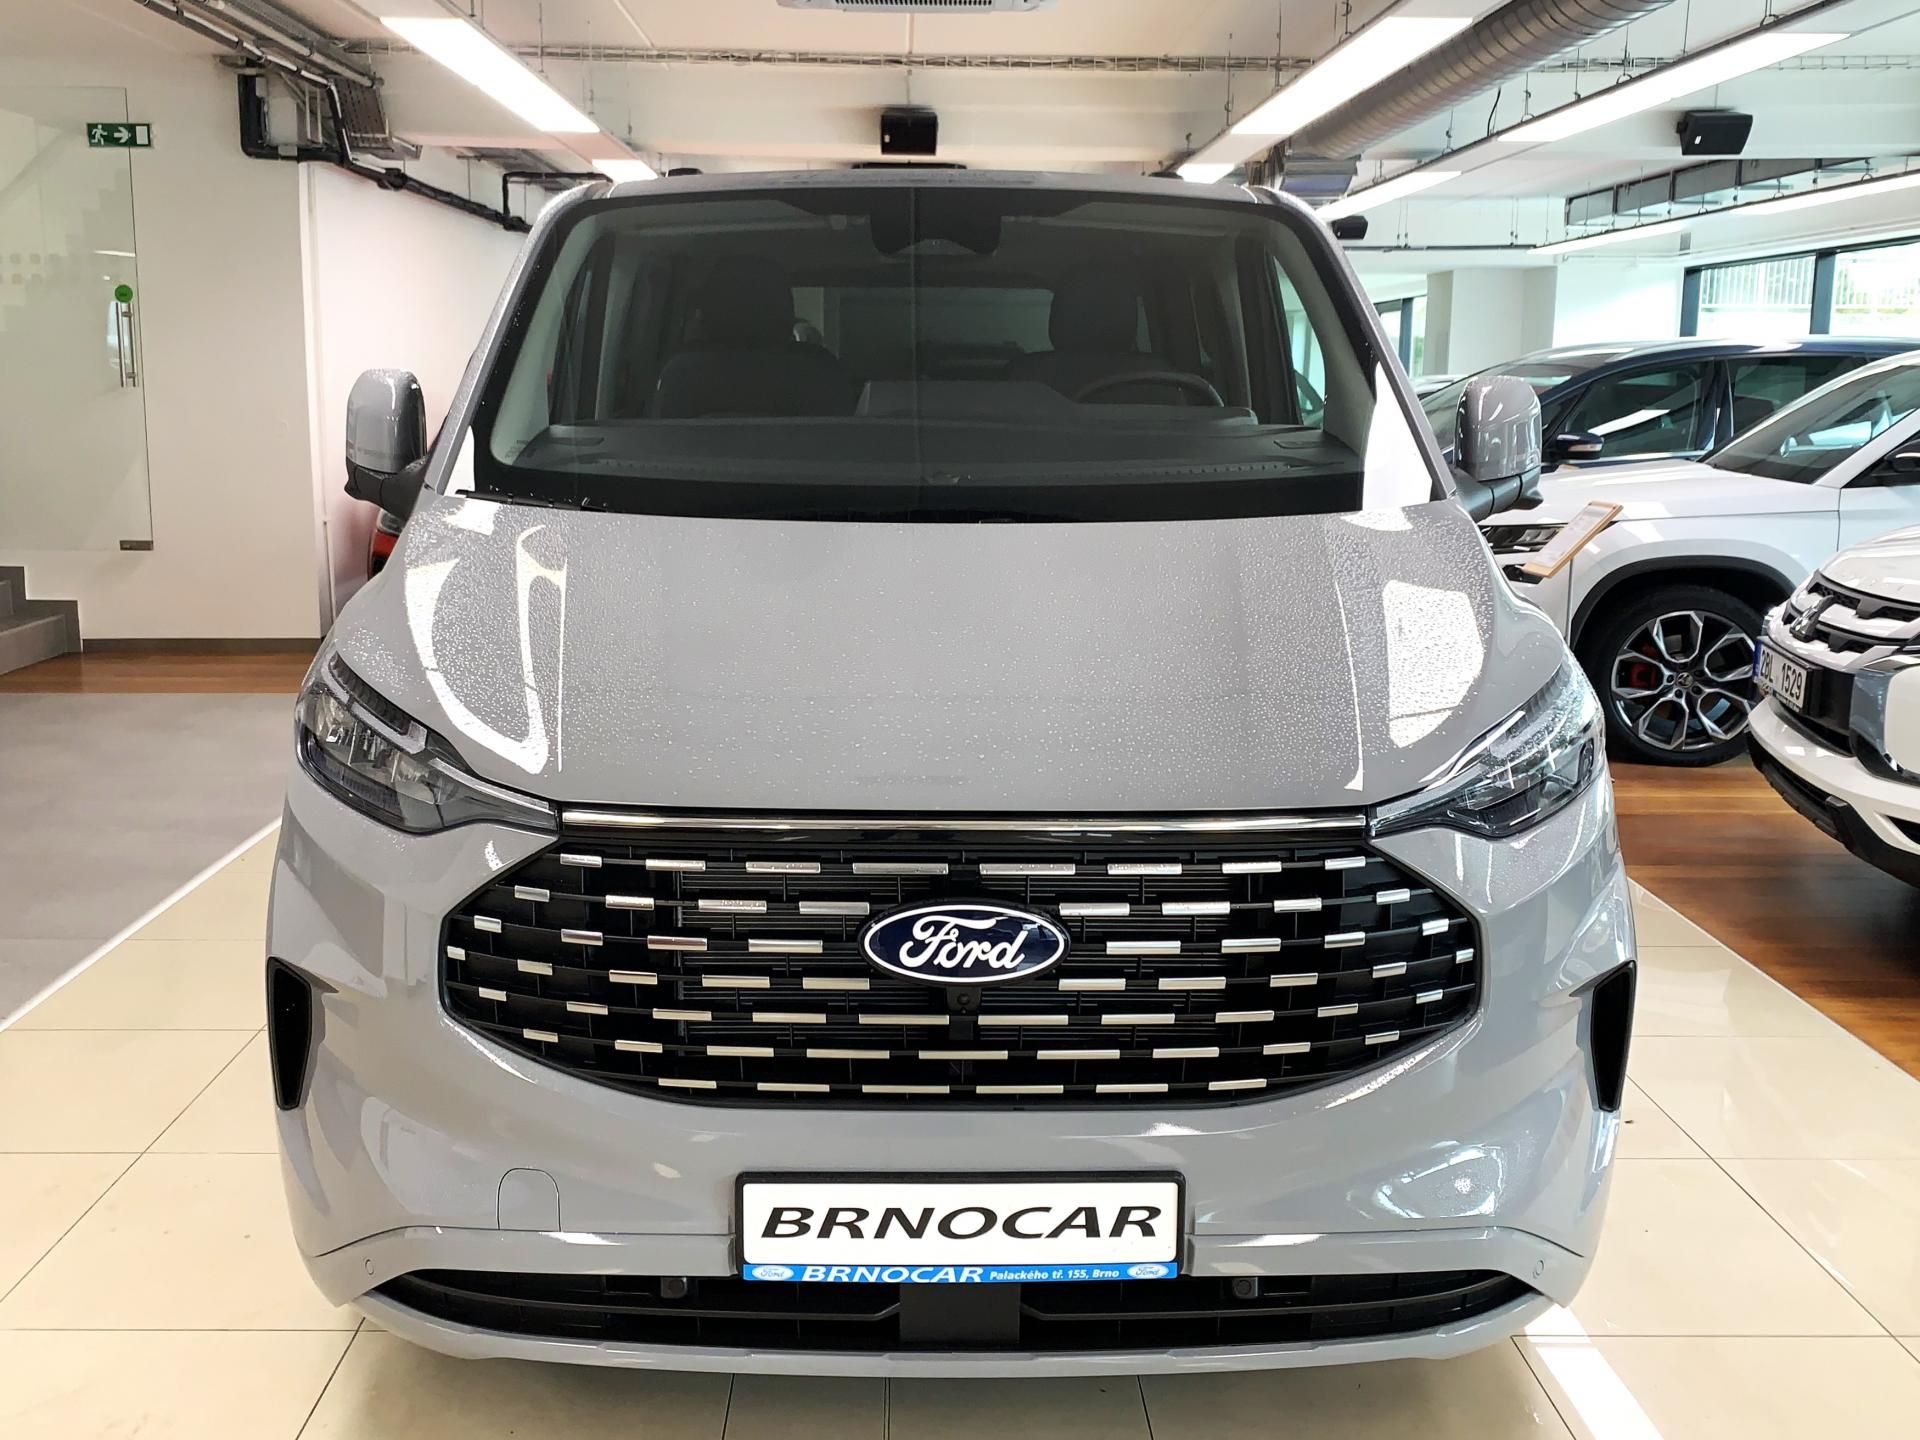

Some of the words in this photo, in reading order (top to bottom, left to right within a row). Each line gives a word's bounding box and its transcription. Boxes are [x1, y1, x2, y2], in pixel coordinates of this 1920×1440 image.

[1760, 649, 1774, 683] 2BL
[1781, 662, 1803, 700] 1529
[899, 915, 1029, 969] Ford
[761, 1206, 1162, 1239] BRNOCAR
[802, 1265, 984, 1283] BRNOCAR
[989, 1270, 1049, 1281] Palackého
[1052, 1269, 1064, 1280] tř.
[1067, 1269, 1090, 1280] 155,
[1092, 1268, 1120, 1279] Brno
